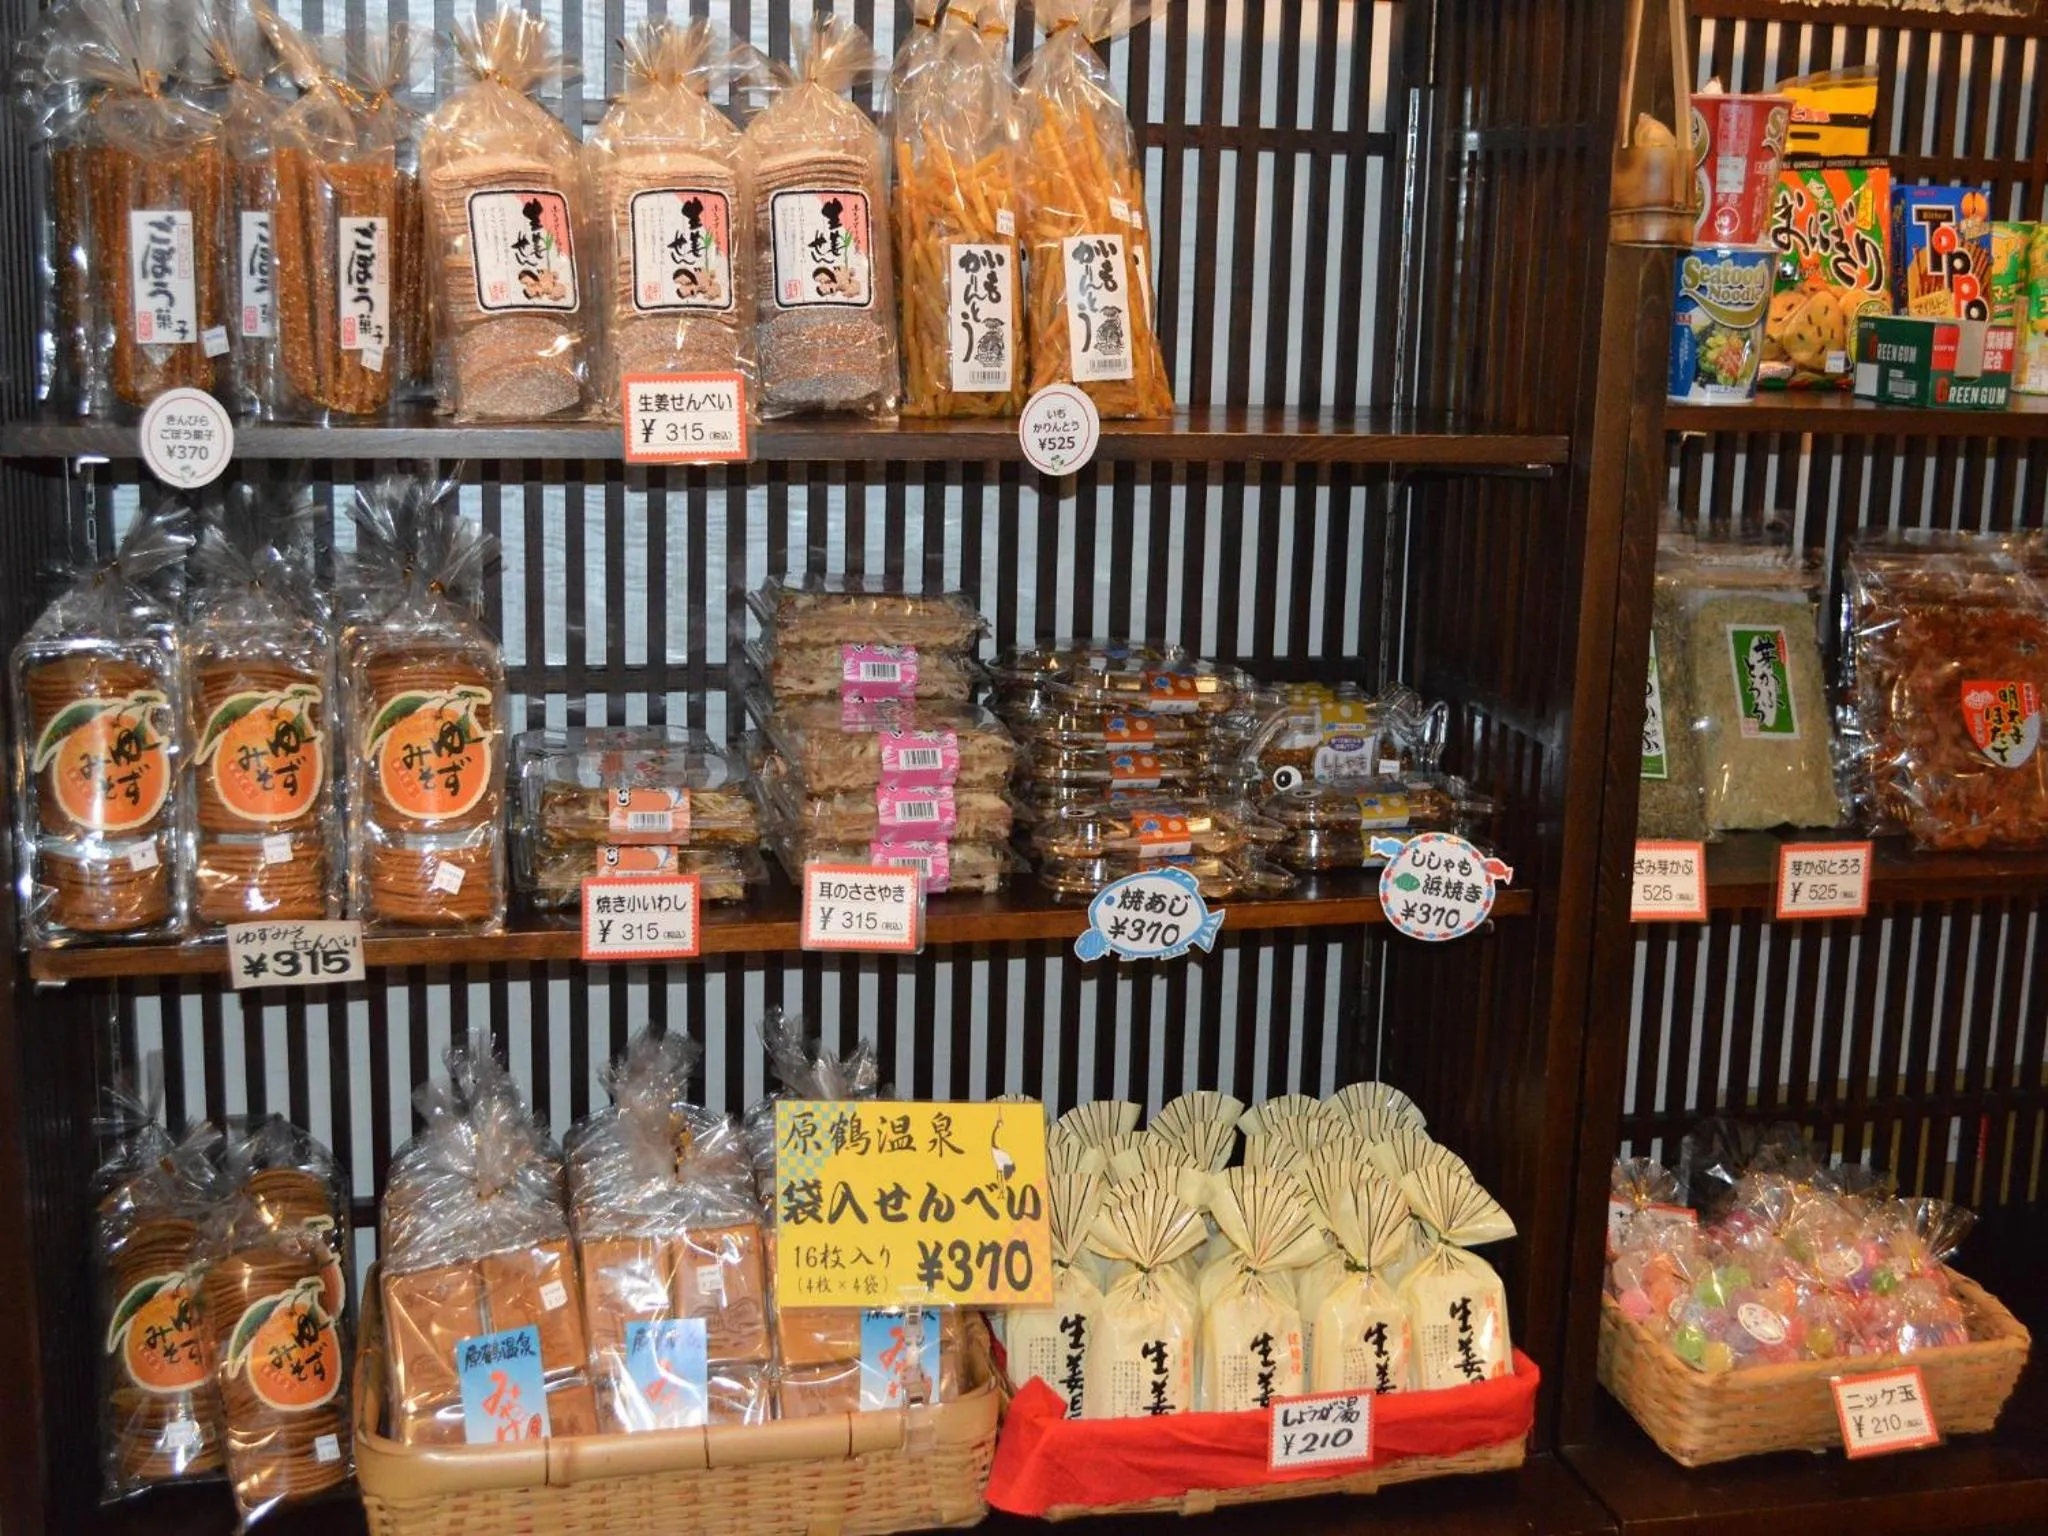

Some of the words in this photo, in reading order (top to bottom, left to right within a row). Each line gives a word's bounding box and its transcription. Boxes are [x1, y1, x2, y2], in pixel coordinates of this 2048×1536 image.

[1682, 256, 1768, 290] Seafood
[638, 393, 733, 412] 生姜せんべい
[1046, 408, 1066, 420] いも
[1032, 420, 1080, 434] かりんとう
[166, 444, 209, 461] ¥370
[1037, 436, 1076, 451] ¥525
[237, 743, 275, 792] みそ
[265, 720, 306, 797] ゆず
[402, 742, 436, 791] みそ
[431, 720, 472, 797] ゆず
[1411, 848, 1473, 877] ししゃも
[818, 881, 905, 903] 耳のささやき
[1117, 886, 1192, 917] 焼あじ
[1422, 873, 1483, 904] 浜焼き
[1643, 884, 1673, 901] 525
[596, 895, 688, 915] 焼き小いわし
[1400, 898, 1461, 930] ¥370
[1107, 915, 1181, 947] ¥370
[242, 949, 352, 979] ¥315
[783, 1111, 966, 1158] 原鶴温泉
[782, 1179, 1042, 1226] 袋入せんべい
[794, 1244, 892, 1270] 16枚入り
[916, 1239, 1033, 1293] ¥370
[1281, 1396, 1361, 1428] しょうが湯
[1846, 1383, 1918, 1411] ニッケ玉
[1282, 1427, 1354, 1456] ¥210
